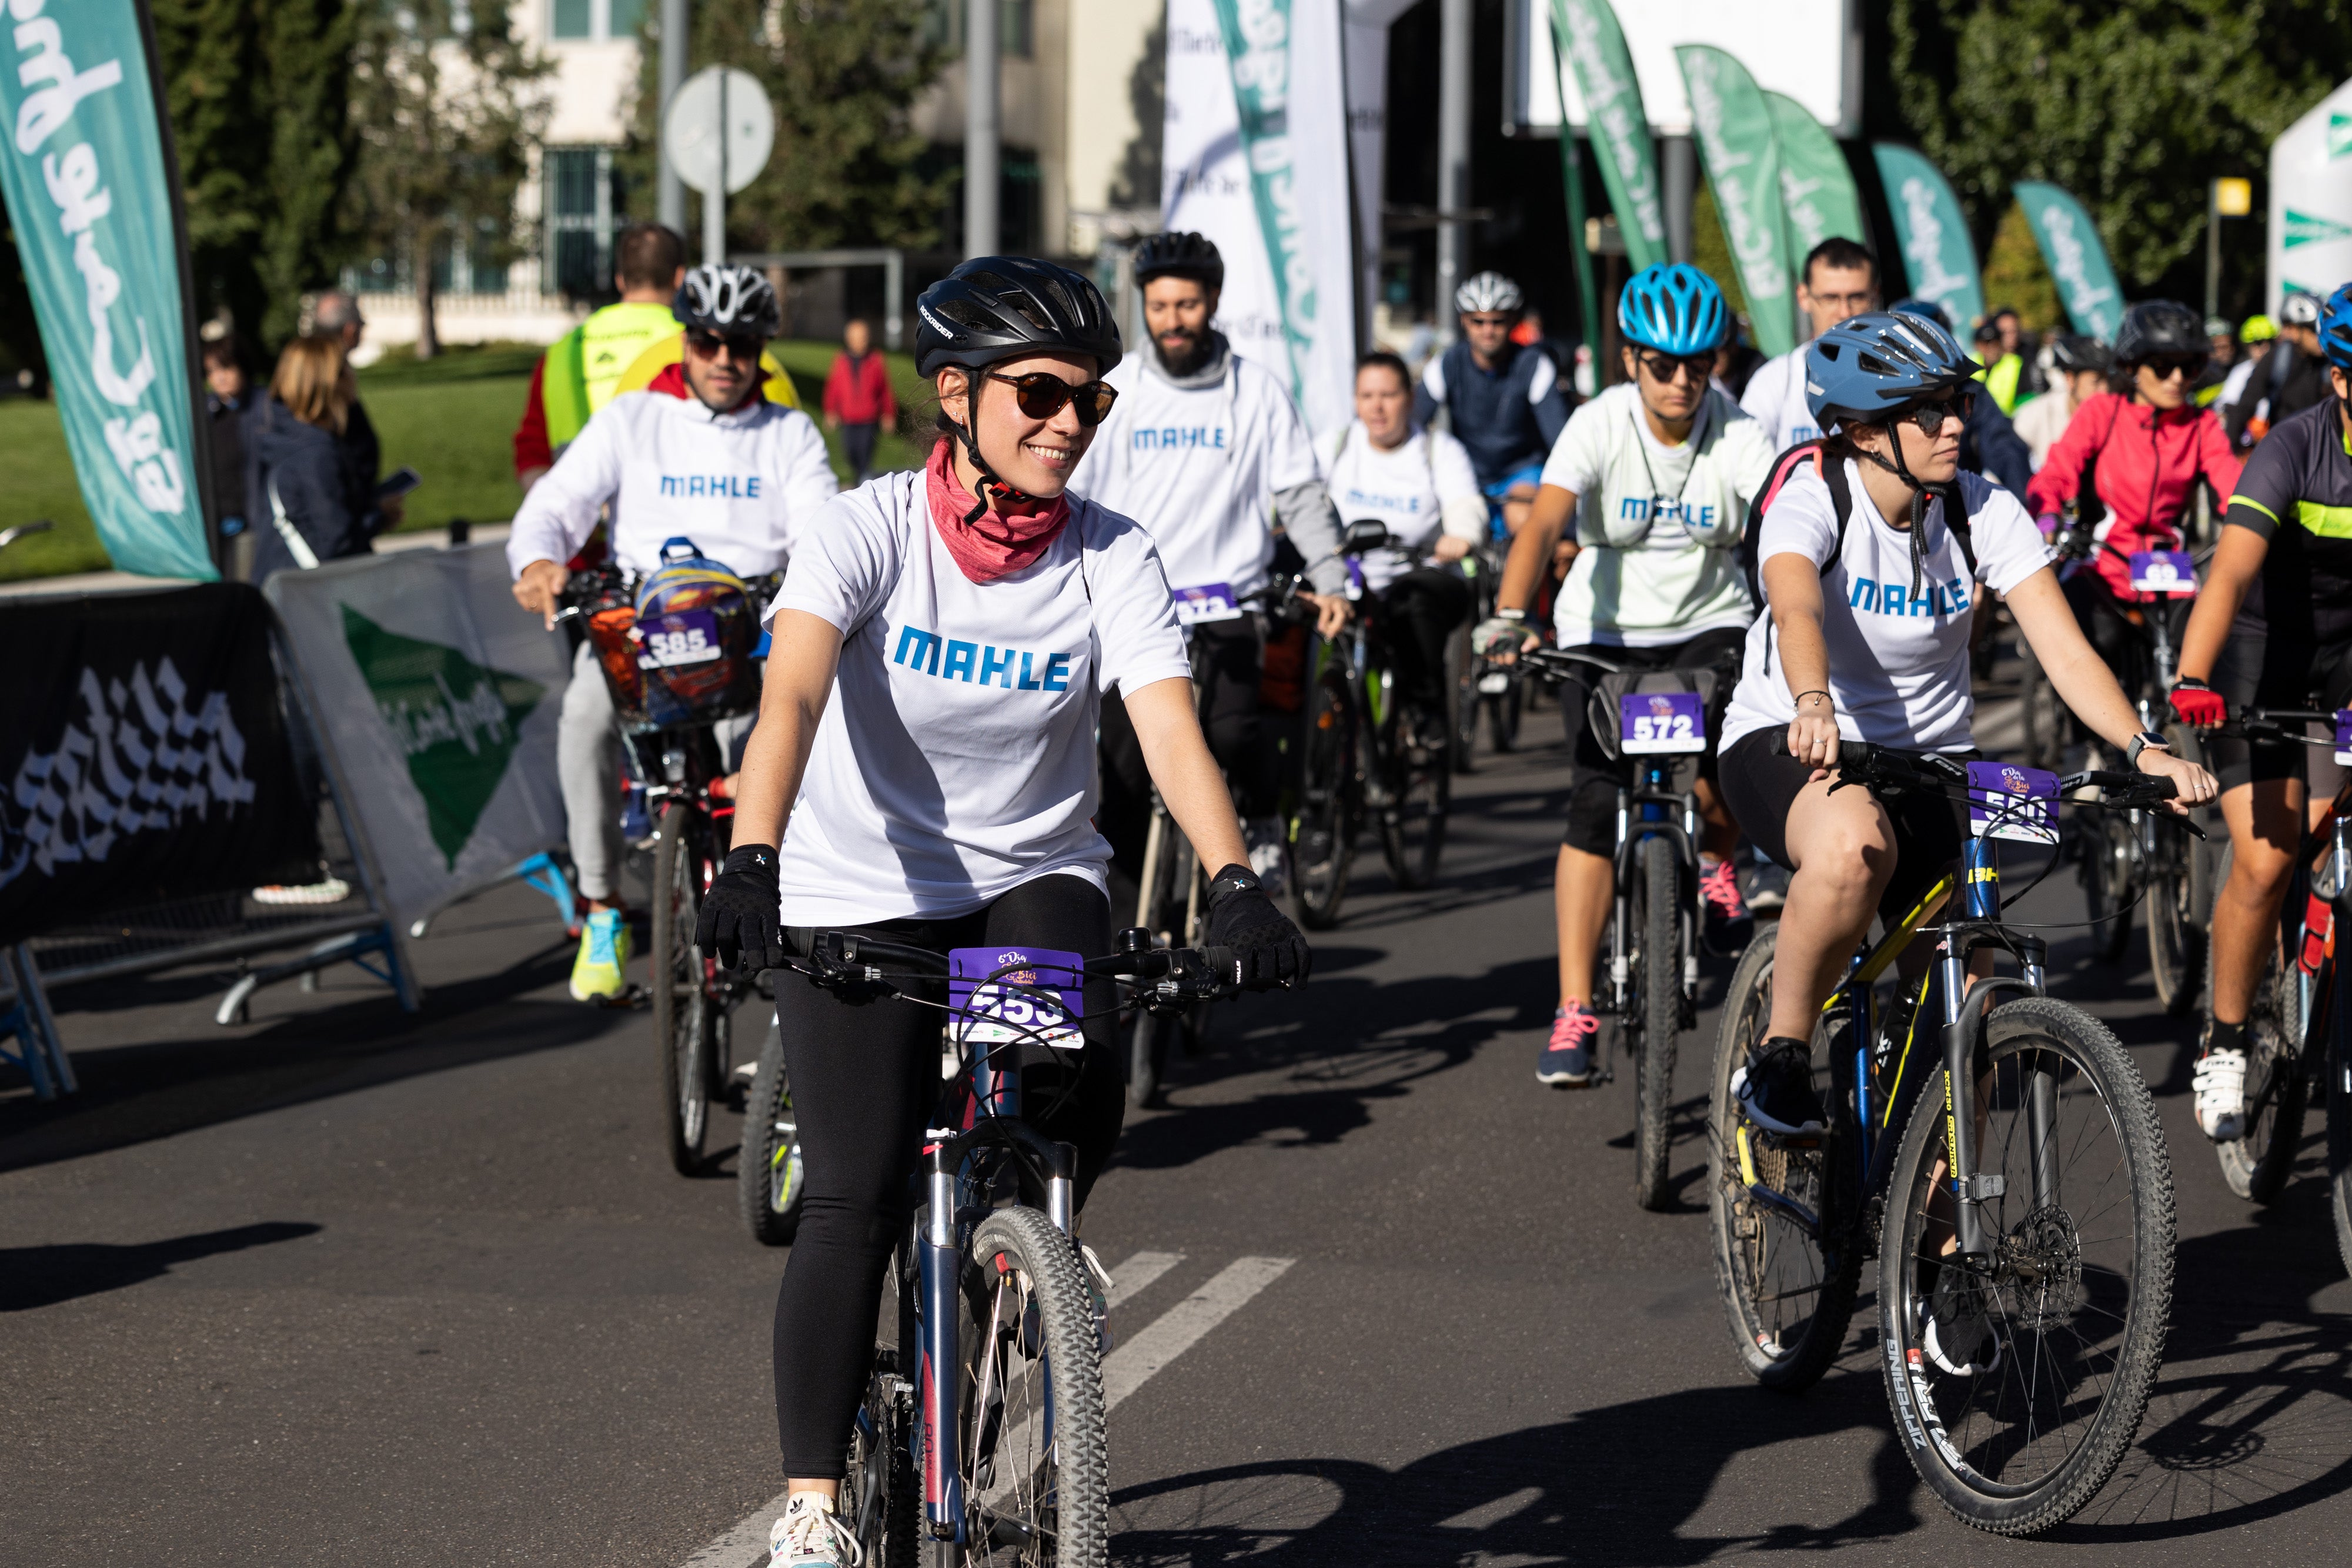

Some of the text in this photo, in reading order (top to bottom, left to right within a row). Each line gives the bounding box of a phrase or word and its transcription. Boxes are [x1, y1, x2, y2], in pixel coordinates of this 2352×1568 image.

[920, 305, 954, 340] ROCKRIDER
[1133, 427, 1225, 449] MAHLE
[660, 475, 761, 499] MAHLE
[1850, 577, 1969, 617] MAHLE
[649, 627, 707, 656] 585
[894, 626, 1071, 691] MAHLE
[1633, 714, 1694, 741] 572
[1984, 791, 2047, 827] 550
[1967, 867, 1999, 884] BH
[972, 985, 1064, 1027] 553
[1944, 1070, 1952, 1111] XCM30
[1886, 1338, 1928, 1450] ZIPPERING
